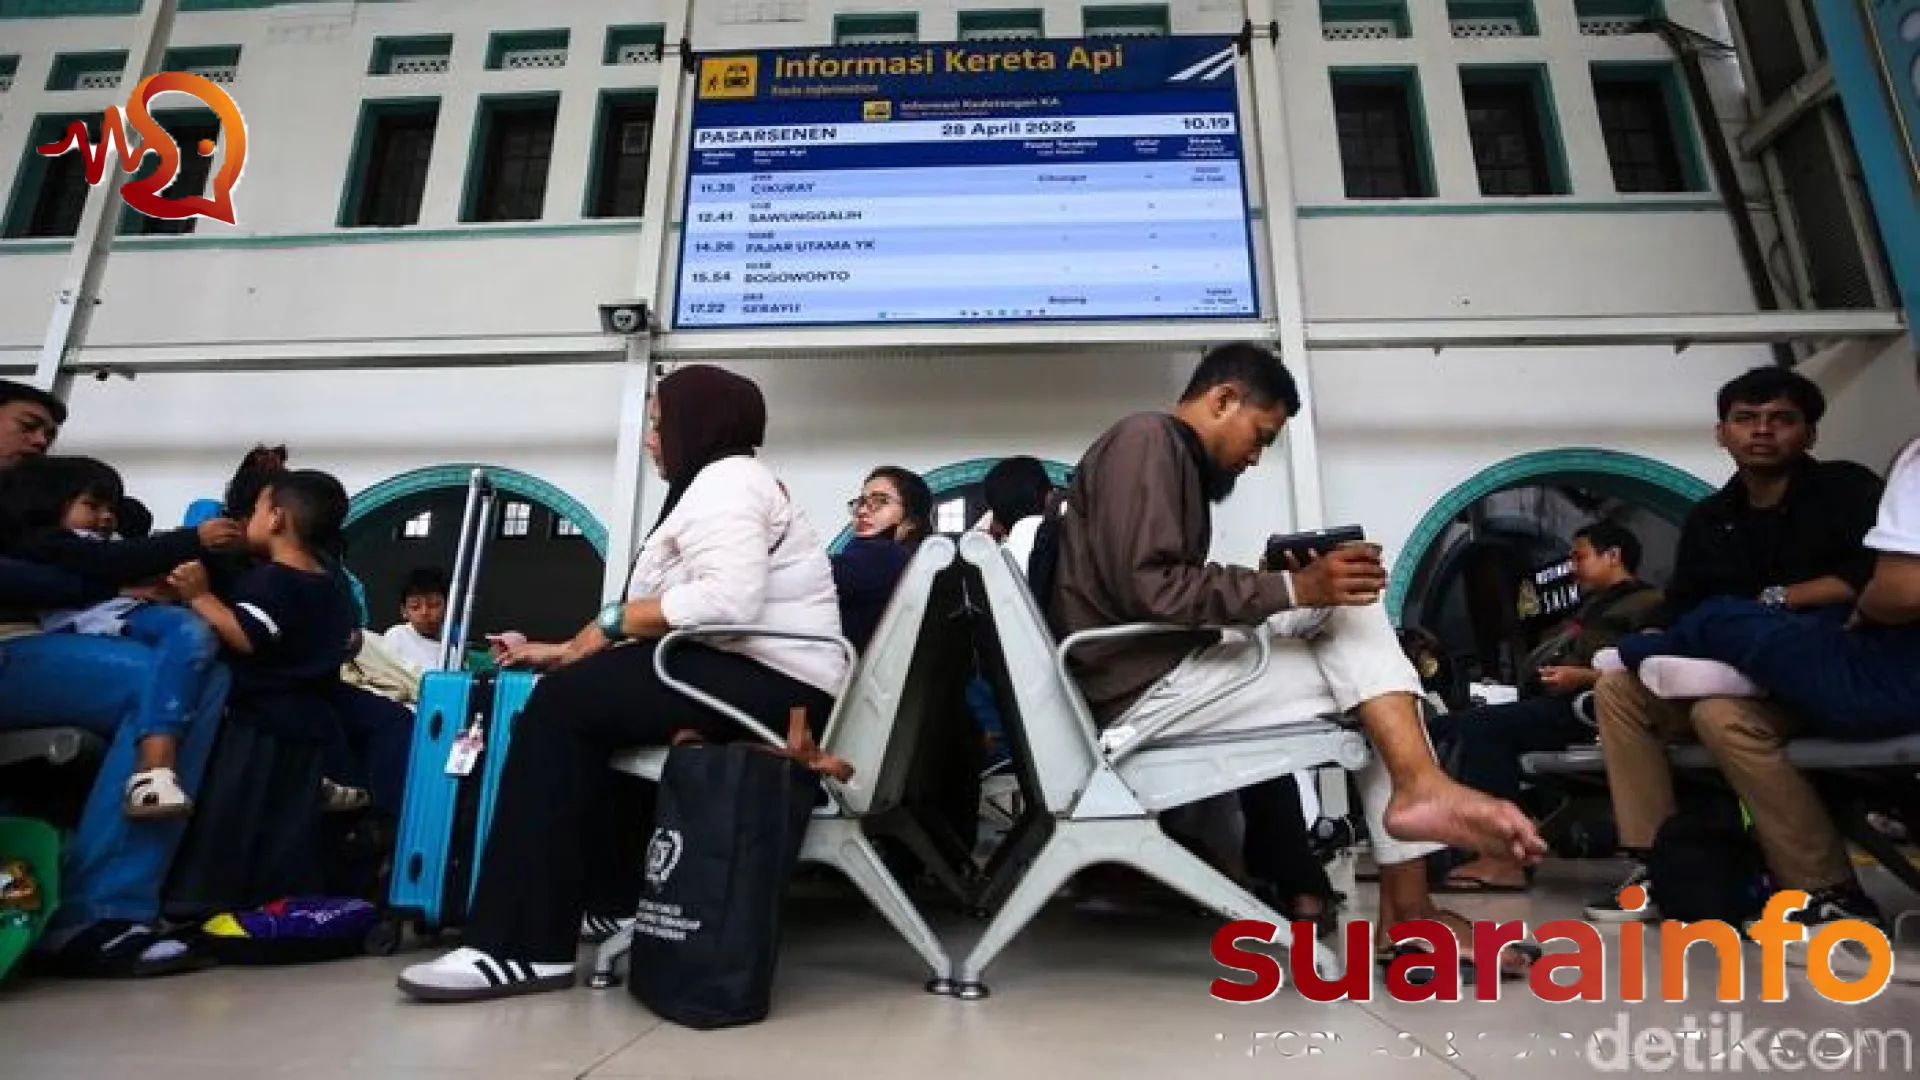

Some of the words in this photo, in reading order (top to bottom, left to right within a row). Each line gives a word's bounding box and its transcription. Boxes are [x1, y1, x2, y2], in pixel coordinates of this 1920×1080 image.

[775, 50, 934, 78] Informasi
[945, 48, 1056, 73] Kereta
[1066, 44, 1123, 75] Api
[940, 124, 966, 136] 28
[970, 121, 1021, 137] April
[1025, 120, 1077, 134] 2026
[1183, 117, 1230, 131] 10.19
[701, 127, 837, 144] PASARSENEN
[698, 212, 734, 223] 12.41
[748, 210, 863, 223] SAWUNGGALIH
[745, 241, 794, 253] FAJAR
[795, 240, 852, 252] UTAMA
[855, 238, 876, 249] YK
[692, 271, 731, 283] 15.54
[744, 270, 851, 283] BOGOWONTO
